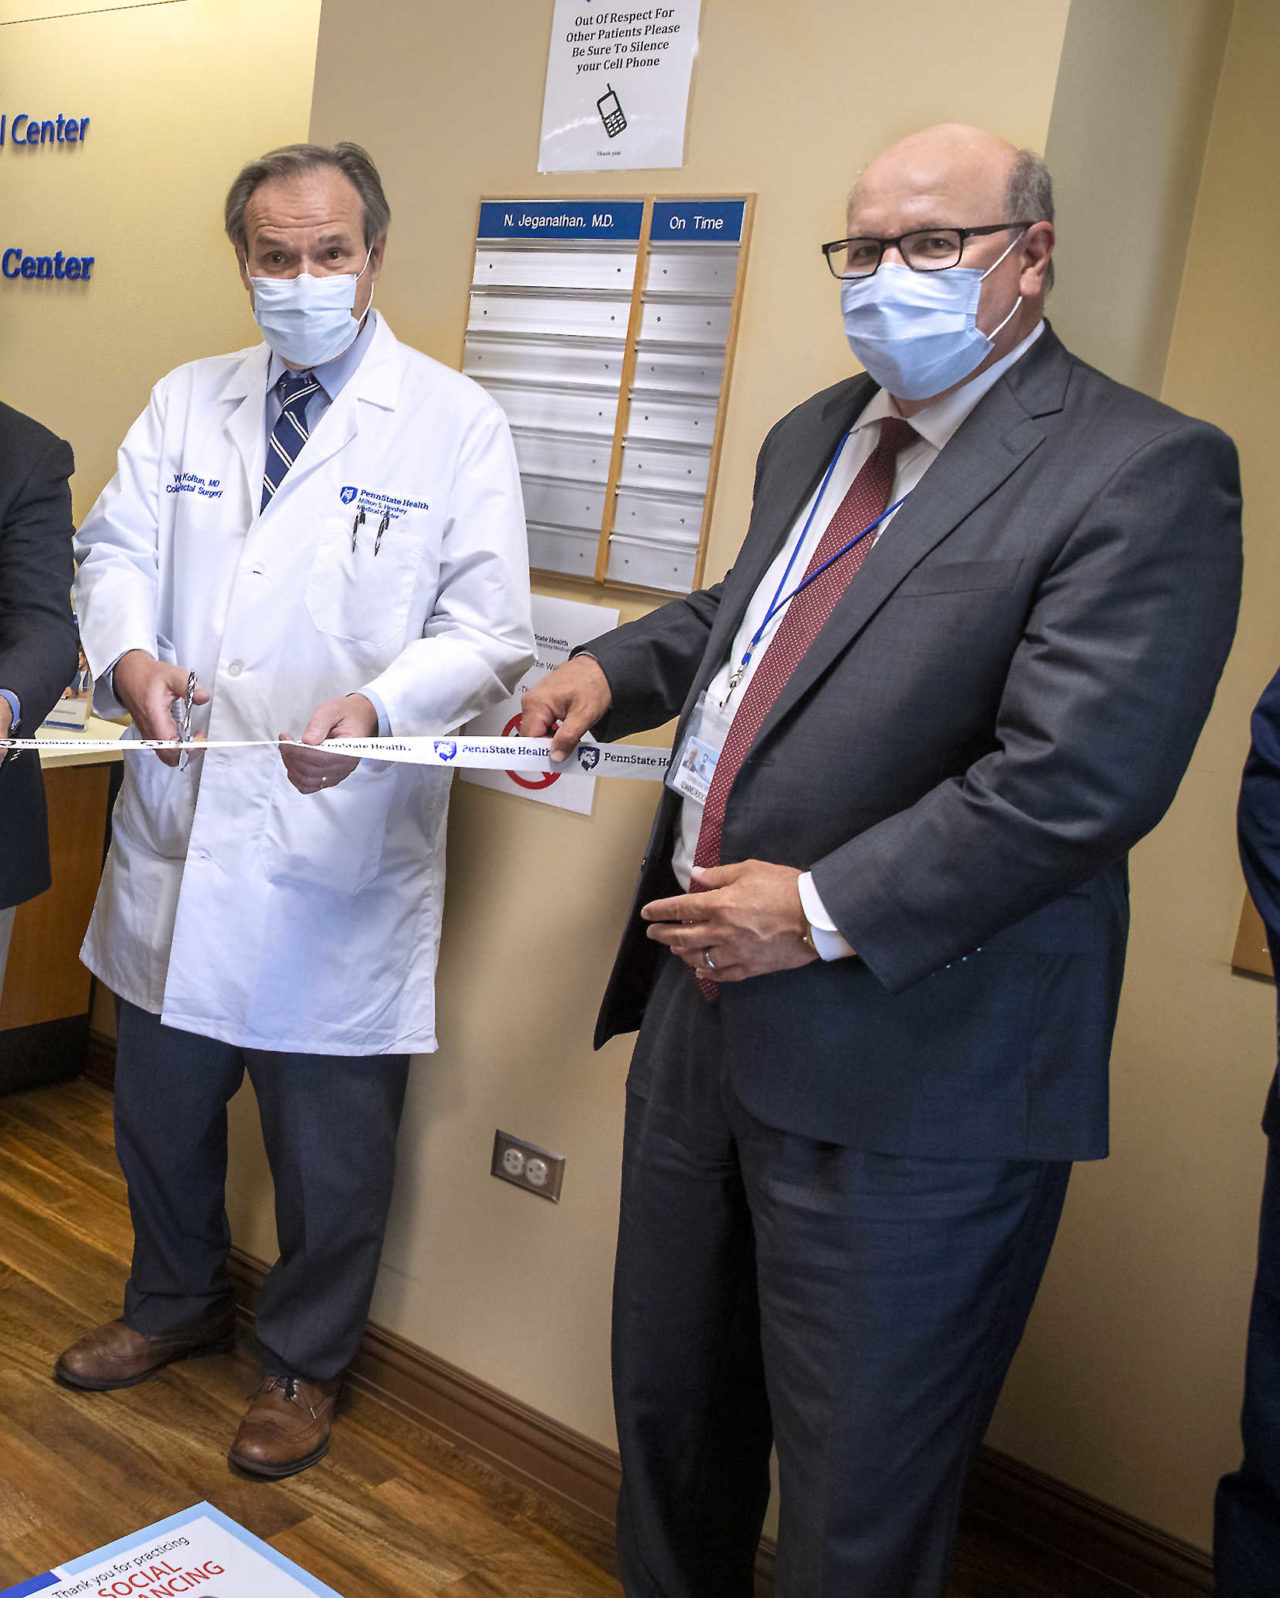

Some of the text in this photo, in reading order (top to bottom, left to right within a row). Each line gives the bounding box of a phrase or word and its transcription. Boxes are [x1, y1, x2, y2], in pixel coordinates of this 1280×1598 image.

[575, 8, 675, 27] Out Of Respect For
[566, 24, 680, 43] Other Patients Please
[572, 40, 669, 58] Be Sure To Silence
[576, 56, 660, 75] your Cell Phone
[11, 113, 91, 144] Center
[504, 213, 614, 229] N. Jeganathan, M.D.
[669, 215, 723, 230] On Time
[2, 248, 95, 280] Center
[198, 486, 223, 498] Surgery
[208, 479, 221, 488] MD
[356, 504, 400, 519] Mdical Ceter
[402, 499, 429, 511] Health
[462, 743, 551, 758] PennState Health
[604, 752, 656, 766] PennState
[52, 1536, 190, 1598] Thank you for practicing
[98, 1561, 183, 1598] SOCIAL
